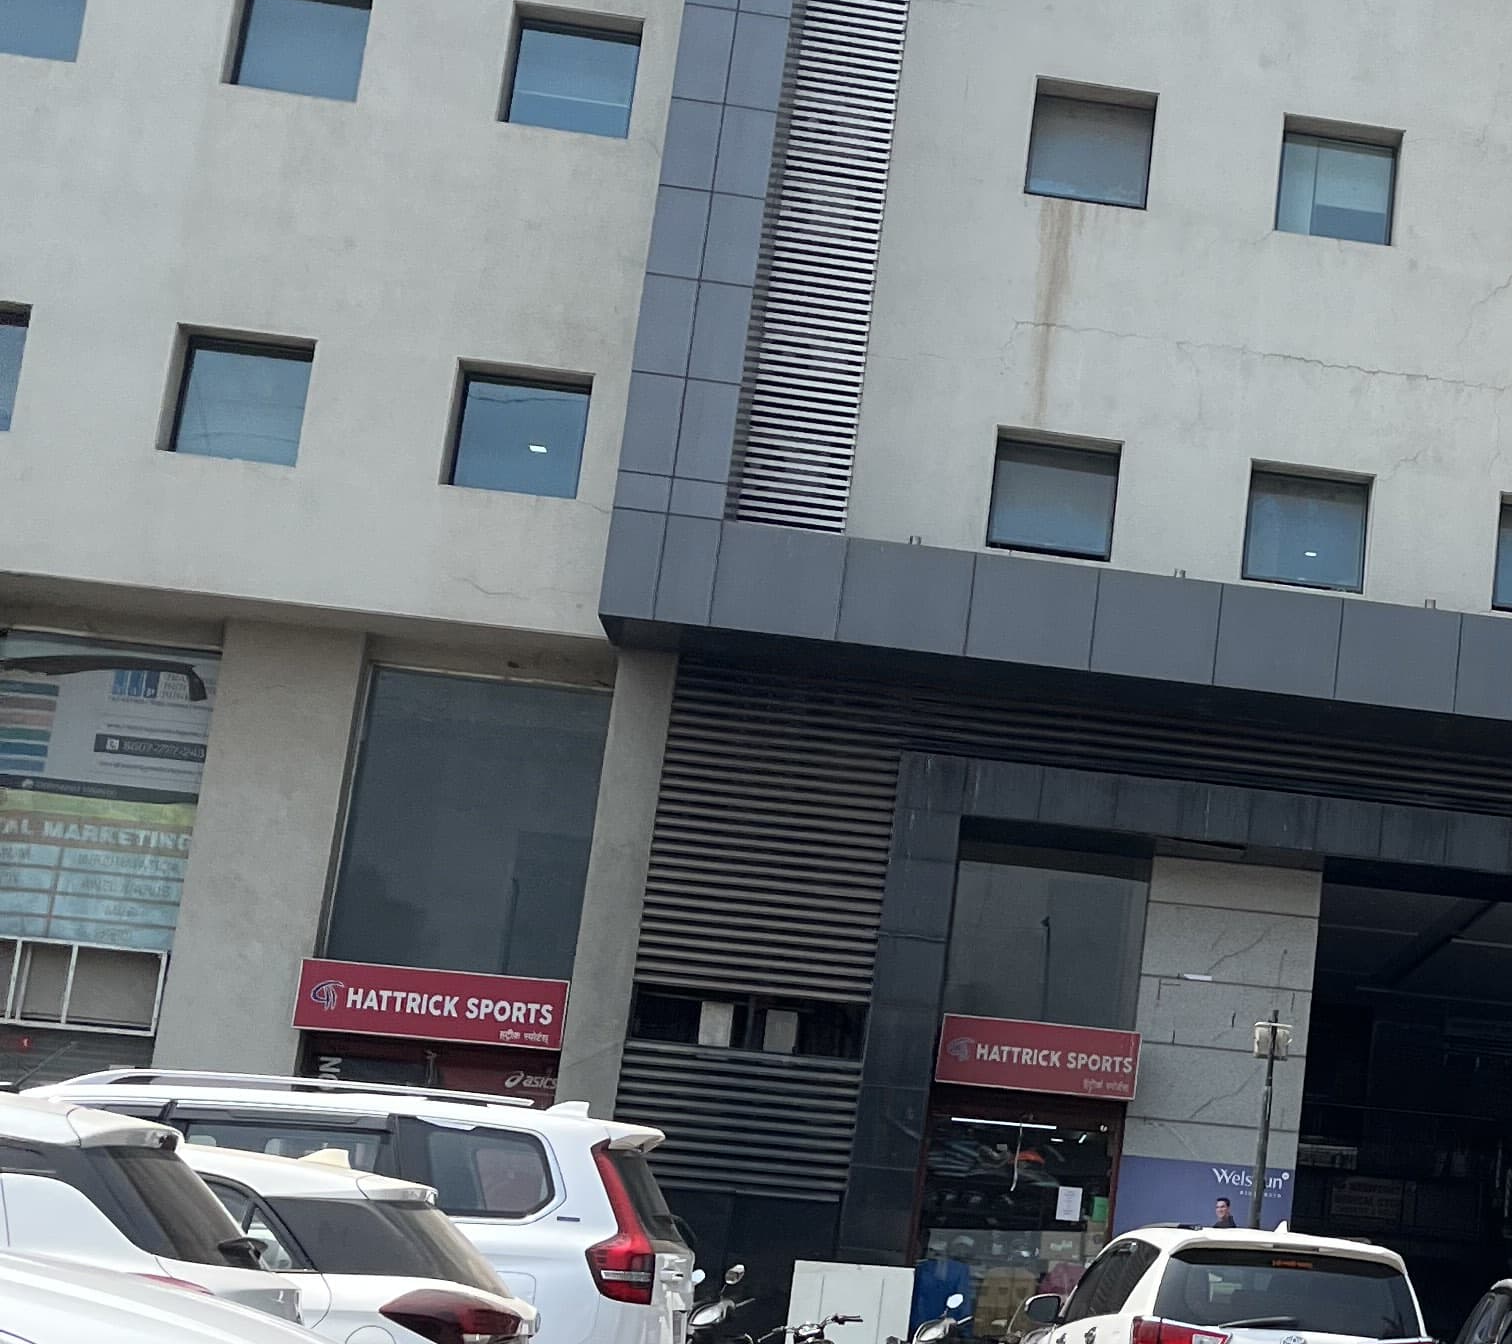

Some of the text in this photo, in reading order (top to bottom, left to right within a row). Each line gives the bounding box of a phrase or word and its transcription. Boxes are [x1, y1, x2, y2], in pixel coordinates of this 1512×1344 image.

[346, 987, 553, 1026] HATTRICK SPORTS
[976, 1043, 1133, 1074] HATTRICK SPORTS
[1212, 1168, 1283, 1190] Welsun
